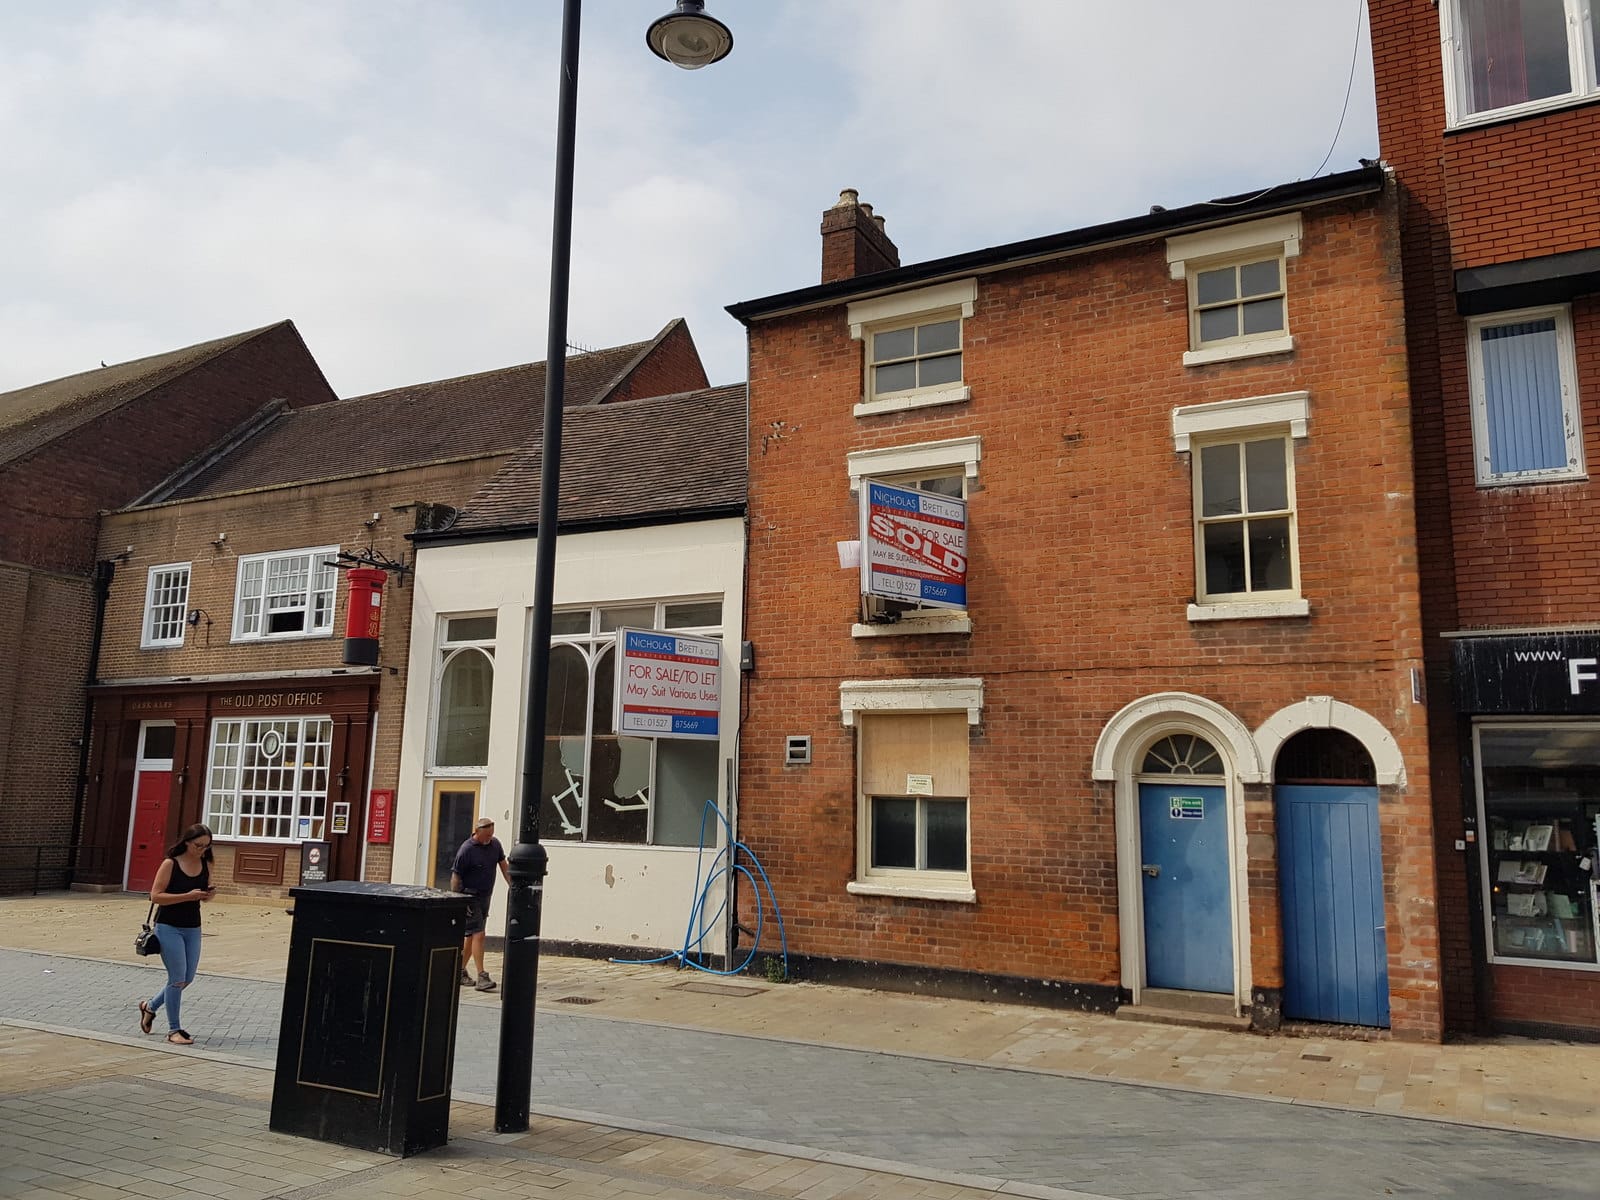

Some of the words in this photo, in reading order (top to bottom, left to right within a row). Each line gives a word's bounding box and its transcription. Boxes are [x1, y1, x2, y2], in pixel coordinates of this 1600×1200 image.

[874, 490, 916, 508] NICHOLAS
[922, 500, 942, 514] BRETT
[950, 510, 960, 518] CO
[871, 512, 966, 574] SOLD
[922, 528, 940, 544] FOR
[942, 533, 964, 548] SALE
[872, 550, 886, 559] MAY
[888, 551, 895, 560] BE
[921, 557, 962, 578] CONTRACT
[882, 578, 894, 588] TEL:
[896, 579, 917, 591] 01527
[924, 585, 947, 596] 875669
[630, 636, 672, 650] NICHOLAS
[678, 642, 698, 653] BRETT
[629, 665, 652, 680] FOR
[656, 668, 698, 684] SALE/TO
[701, 673, 716, 686] LET
[1514, 650, 1566, 662] www.
[1568, 658, 1597, 695] F
[220, 697, 232, 706] THE
[235, 695, 254, 707] OLD
[257, 694, 284, 707] POST
[287, 692, 322, 706] OFFICE
[627, 684, 648, 698] May
[652, 685, 666, 696] Suit
[669, 686, 696, 699] Various
[700, 690, 718, 701] Uses
[633, 718, 645, 726] TEL:
[648, 718, 668, 727] 01527
[675, 720, 698, 729] 875669
